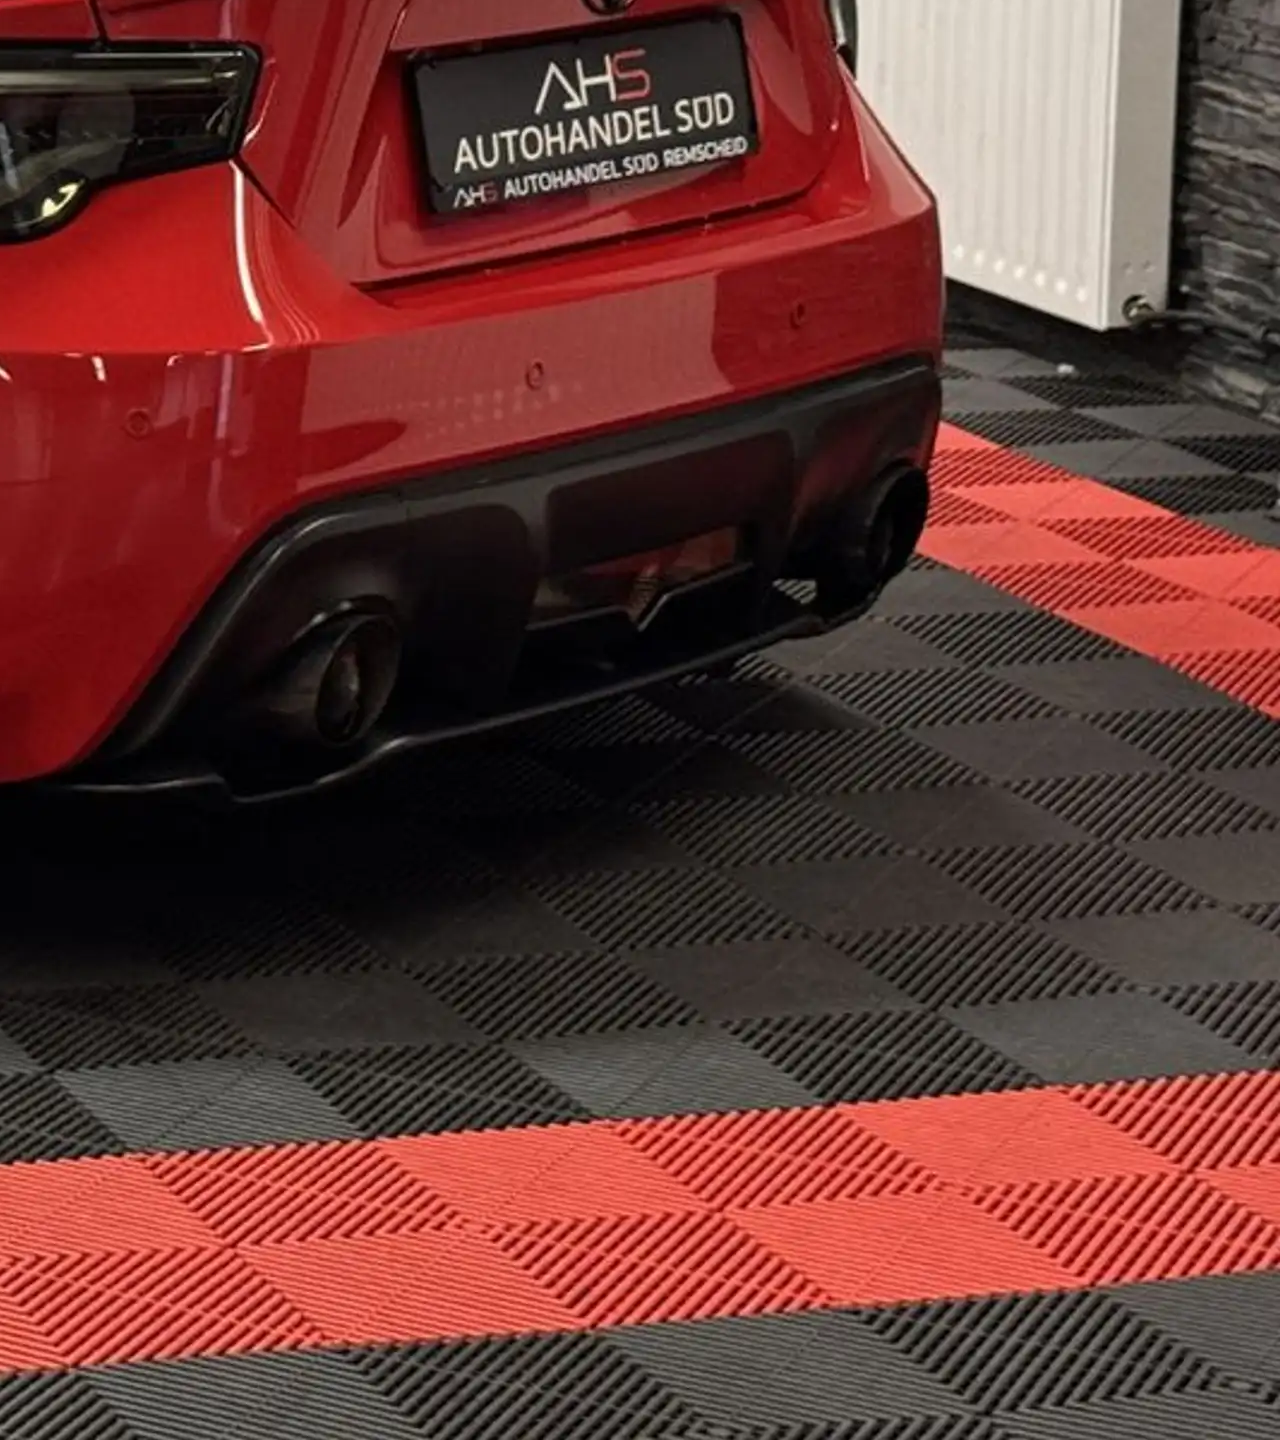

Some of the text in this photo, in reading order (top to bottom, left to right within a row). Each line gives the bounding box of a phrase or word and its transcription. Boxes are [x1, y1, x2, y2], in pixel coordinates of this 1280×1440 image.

[535, 49, 651, 115] AHS
[453, 91, 734, 174] AUTOHANDEL SÜD
[503, 159, 622, 199] AUTOHANDEL
[663, 135, 748, 168] REMSCHEID
